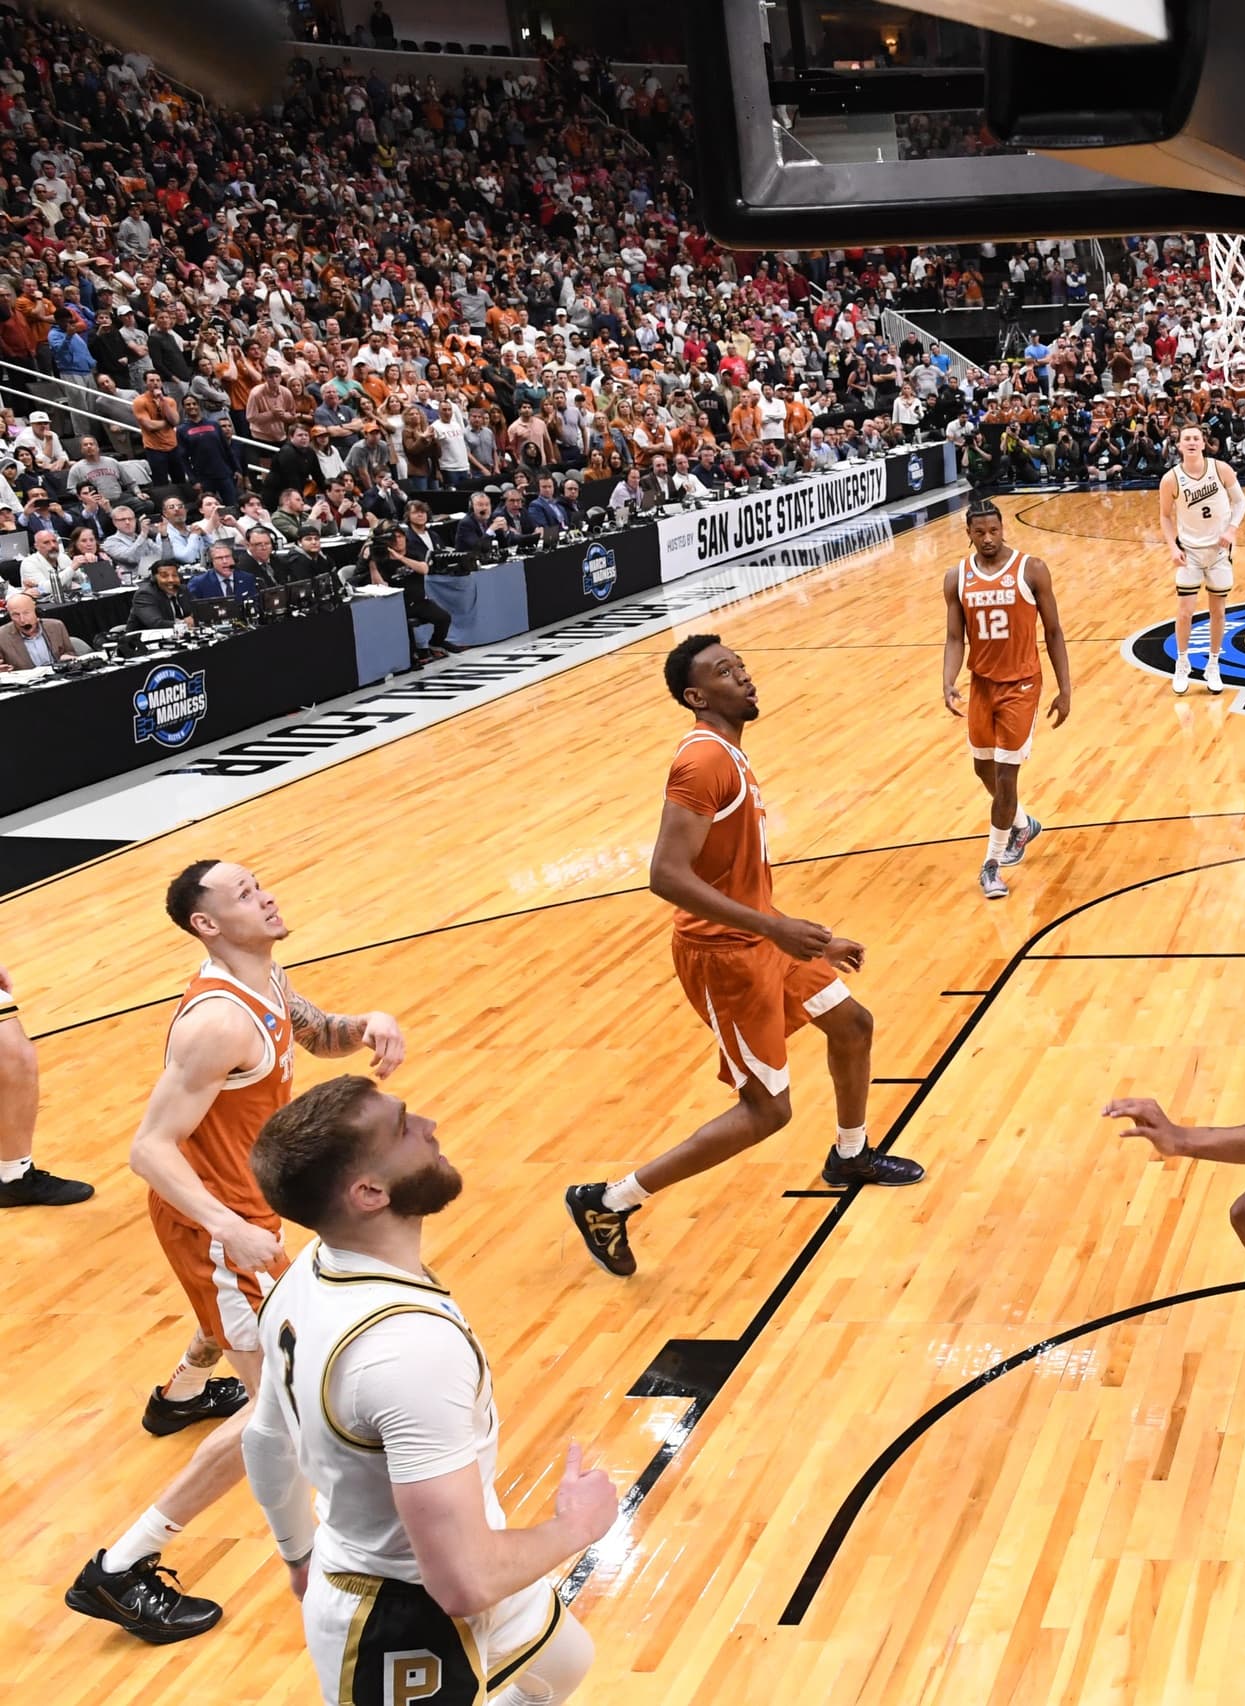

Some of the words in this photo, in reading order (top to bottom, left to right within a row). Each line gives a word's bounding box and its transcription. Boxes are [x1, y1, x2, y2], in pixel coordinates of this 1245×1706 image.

[1183, 482, 1219, 505] Purdue
[698, 511, 729, 560] SAN
[734, 499, 772, 548] JOSE
[777, 486, 815, 535] STATE
[817, 466, 883, 520] UNIVERSITY
[1202, 506, 1212, 519] 2
[686, 532, 694, 546] BY
[965, 589, 1016, 608] TEXAS
[538, 602, 670, 641] ROAD
[976, 608, 1009, 640] 12
[355, 653, 564, 706] FINAL
[148, 682, 186, 709] MARCH
[156, 694, 205, 724] MADNESS
[157, 709, 413, 777] FOUR
[384, 1649, 442, 1706] P
